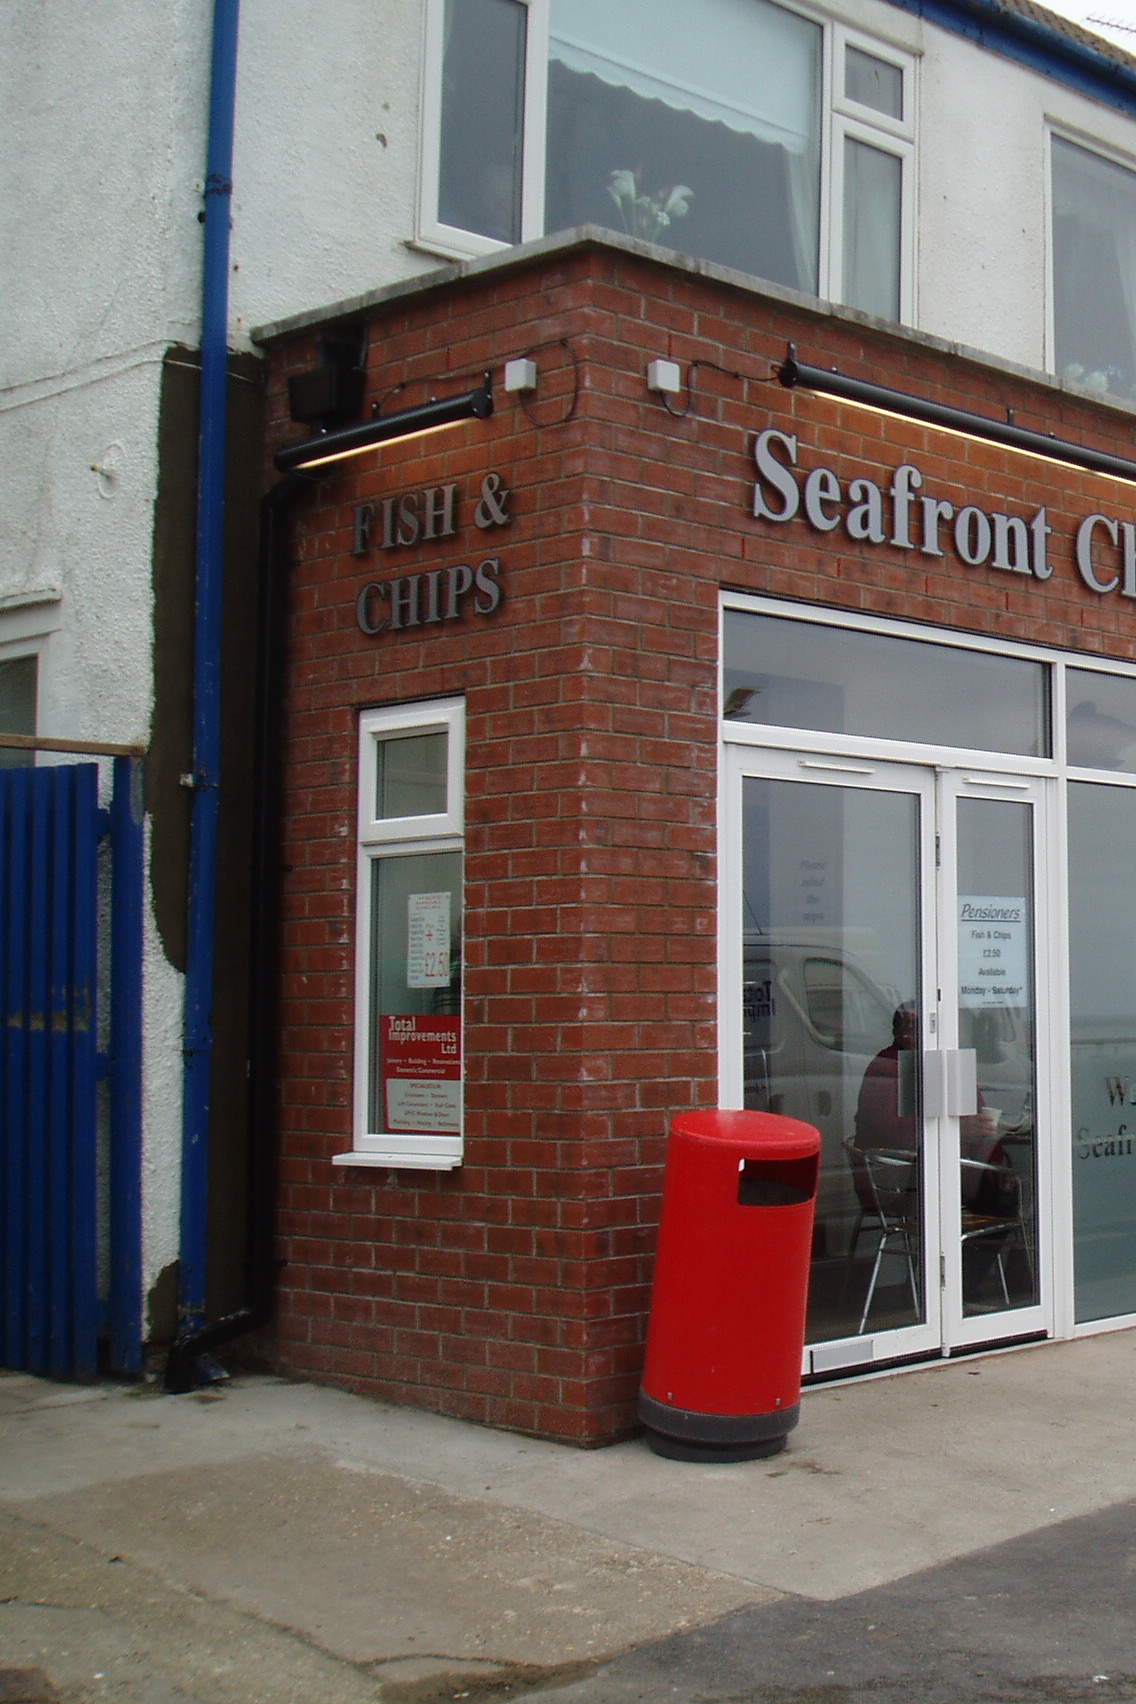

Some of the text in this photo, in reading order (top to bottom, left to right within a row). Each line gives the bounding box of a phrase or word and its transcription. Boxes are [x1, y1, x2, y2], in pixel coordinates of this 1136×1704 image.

[754, 428, 1054, 581] Seafront
[353, 471, 511, 556] FISH &
[357, 556, 501, 636] CHIPS
[961, 903, 1021, 920] Pensioners
[971, 930, 986, 940] Fish
[993, 930, 1012, 941] Chips
[961, 986, 986, 997] Monday
[389, 1016, 416, 1032] Total
[388, 1028, 457, 1045] Improvements
[441, 1043, 457, 1054] Ltd
